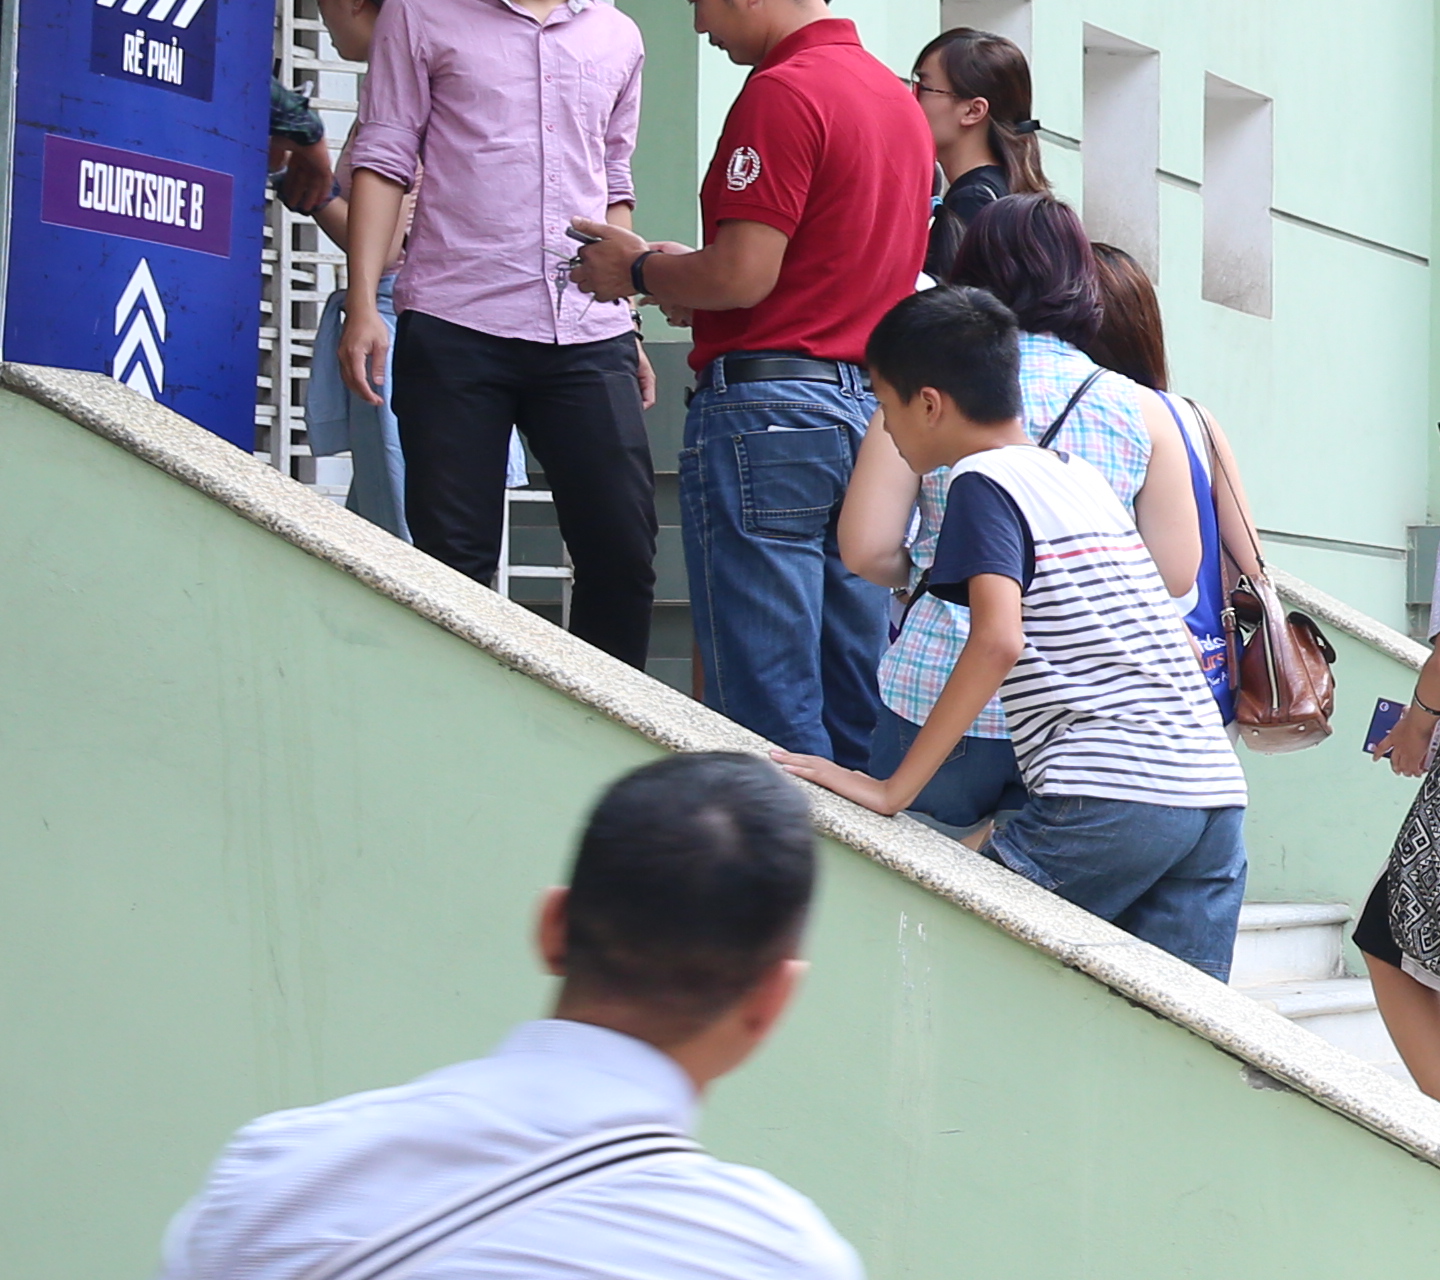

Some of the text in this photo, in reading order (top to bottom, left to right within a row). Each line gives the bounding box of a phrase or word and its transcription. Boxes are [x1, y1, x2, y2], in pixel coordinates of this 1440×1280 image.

[146, 37, 184, 86] PHẢI
[78, 159, 204, 231] COURTSIDE B
